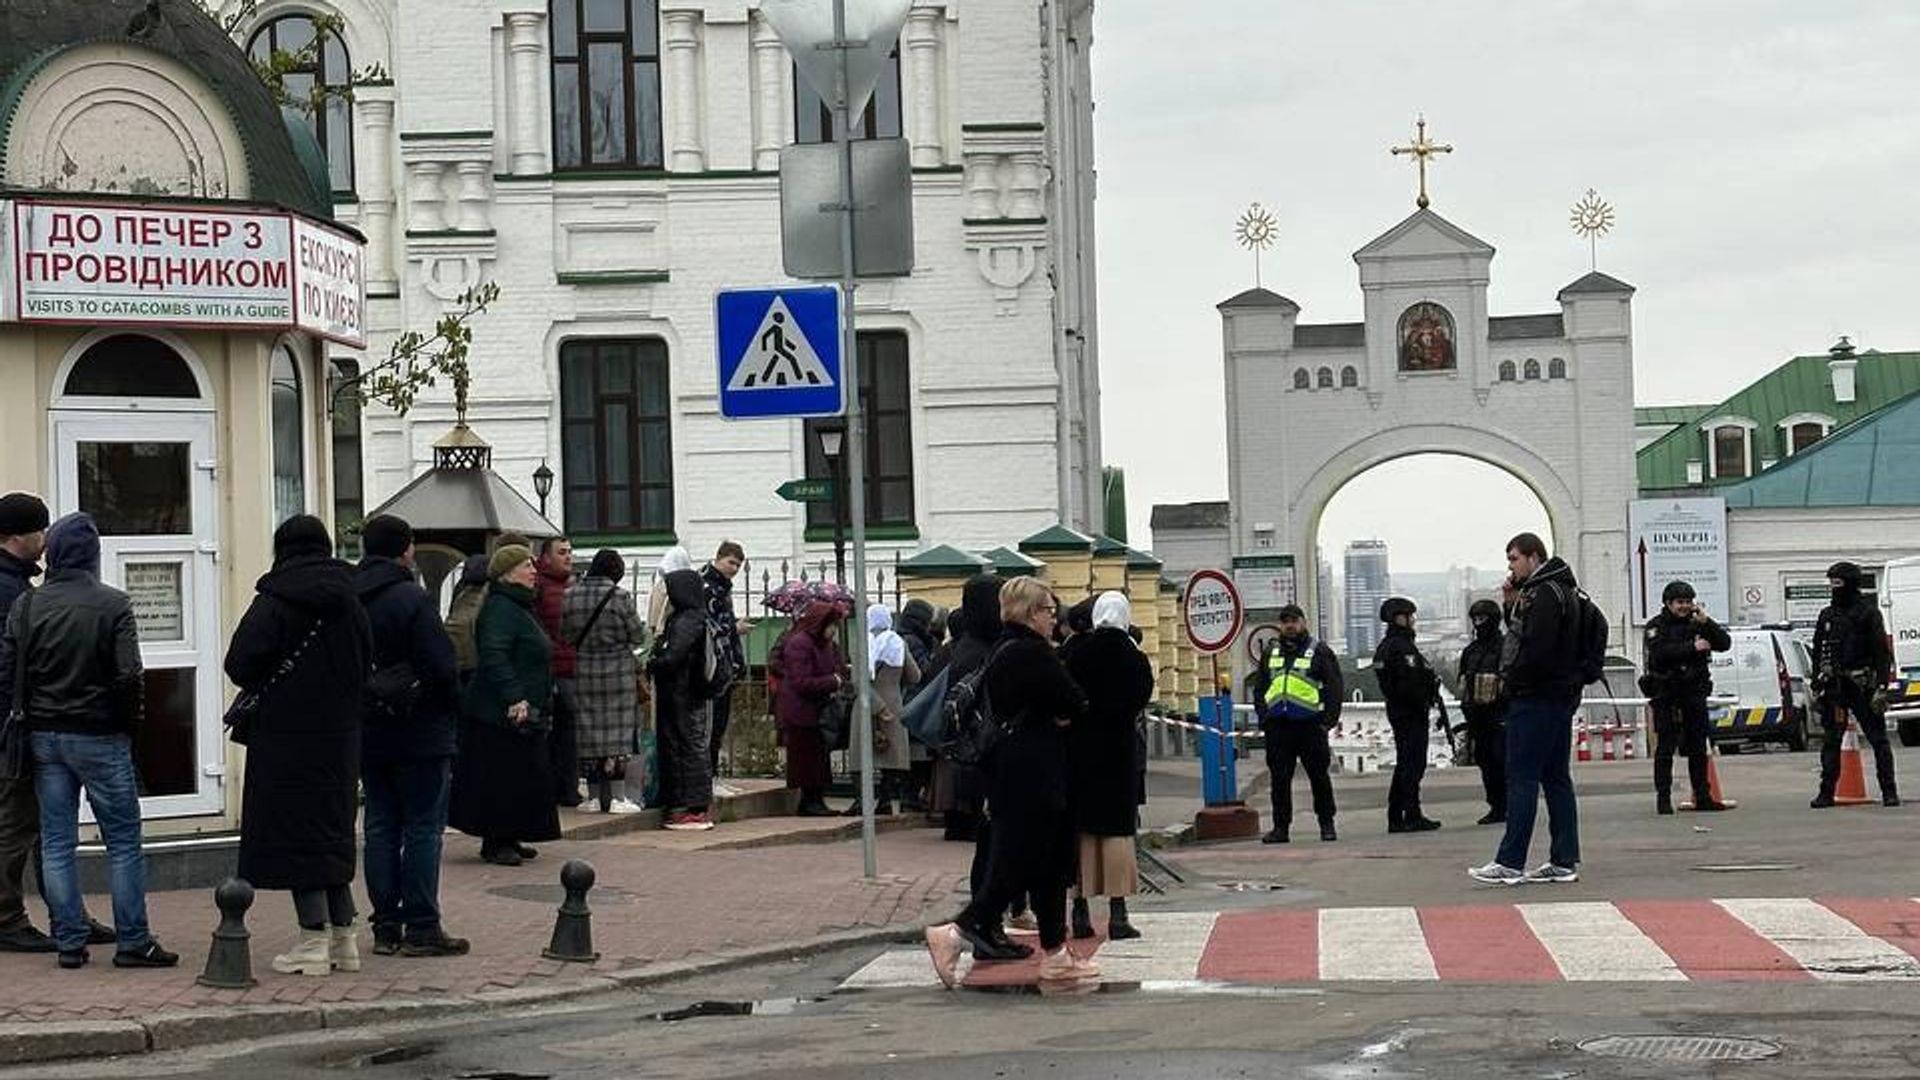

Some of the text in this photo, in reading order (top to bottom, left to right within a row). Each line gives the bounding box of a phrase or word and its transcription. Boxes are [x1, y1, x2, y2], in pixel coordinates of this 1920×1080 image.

[49, 213, 262, 250] ДО ПЕЧЕР З
[26, 252, 288, 290] ПРОВІДНИКОМ
[28, 300, 289, 318] VISITS TO CATACOMBS WITH A GUIDE
[303, 282, 321, 317] ПО
